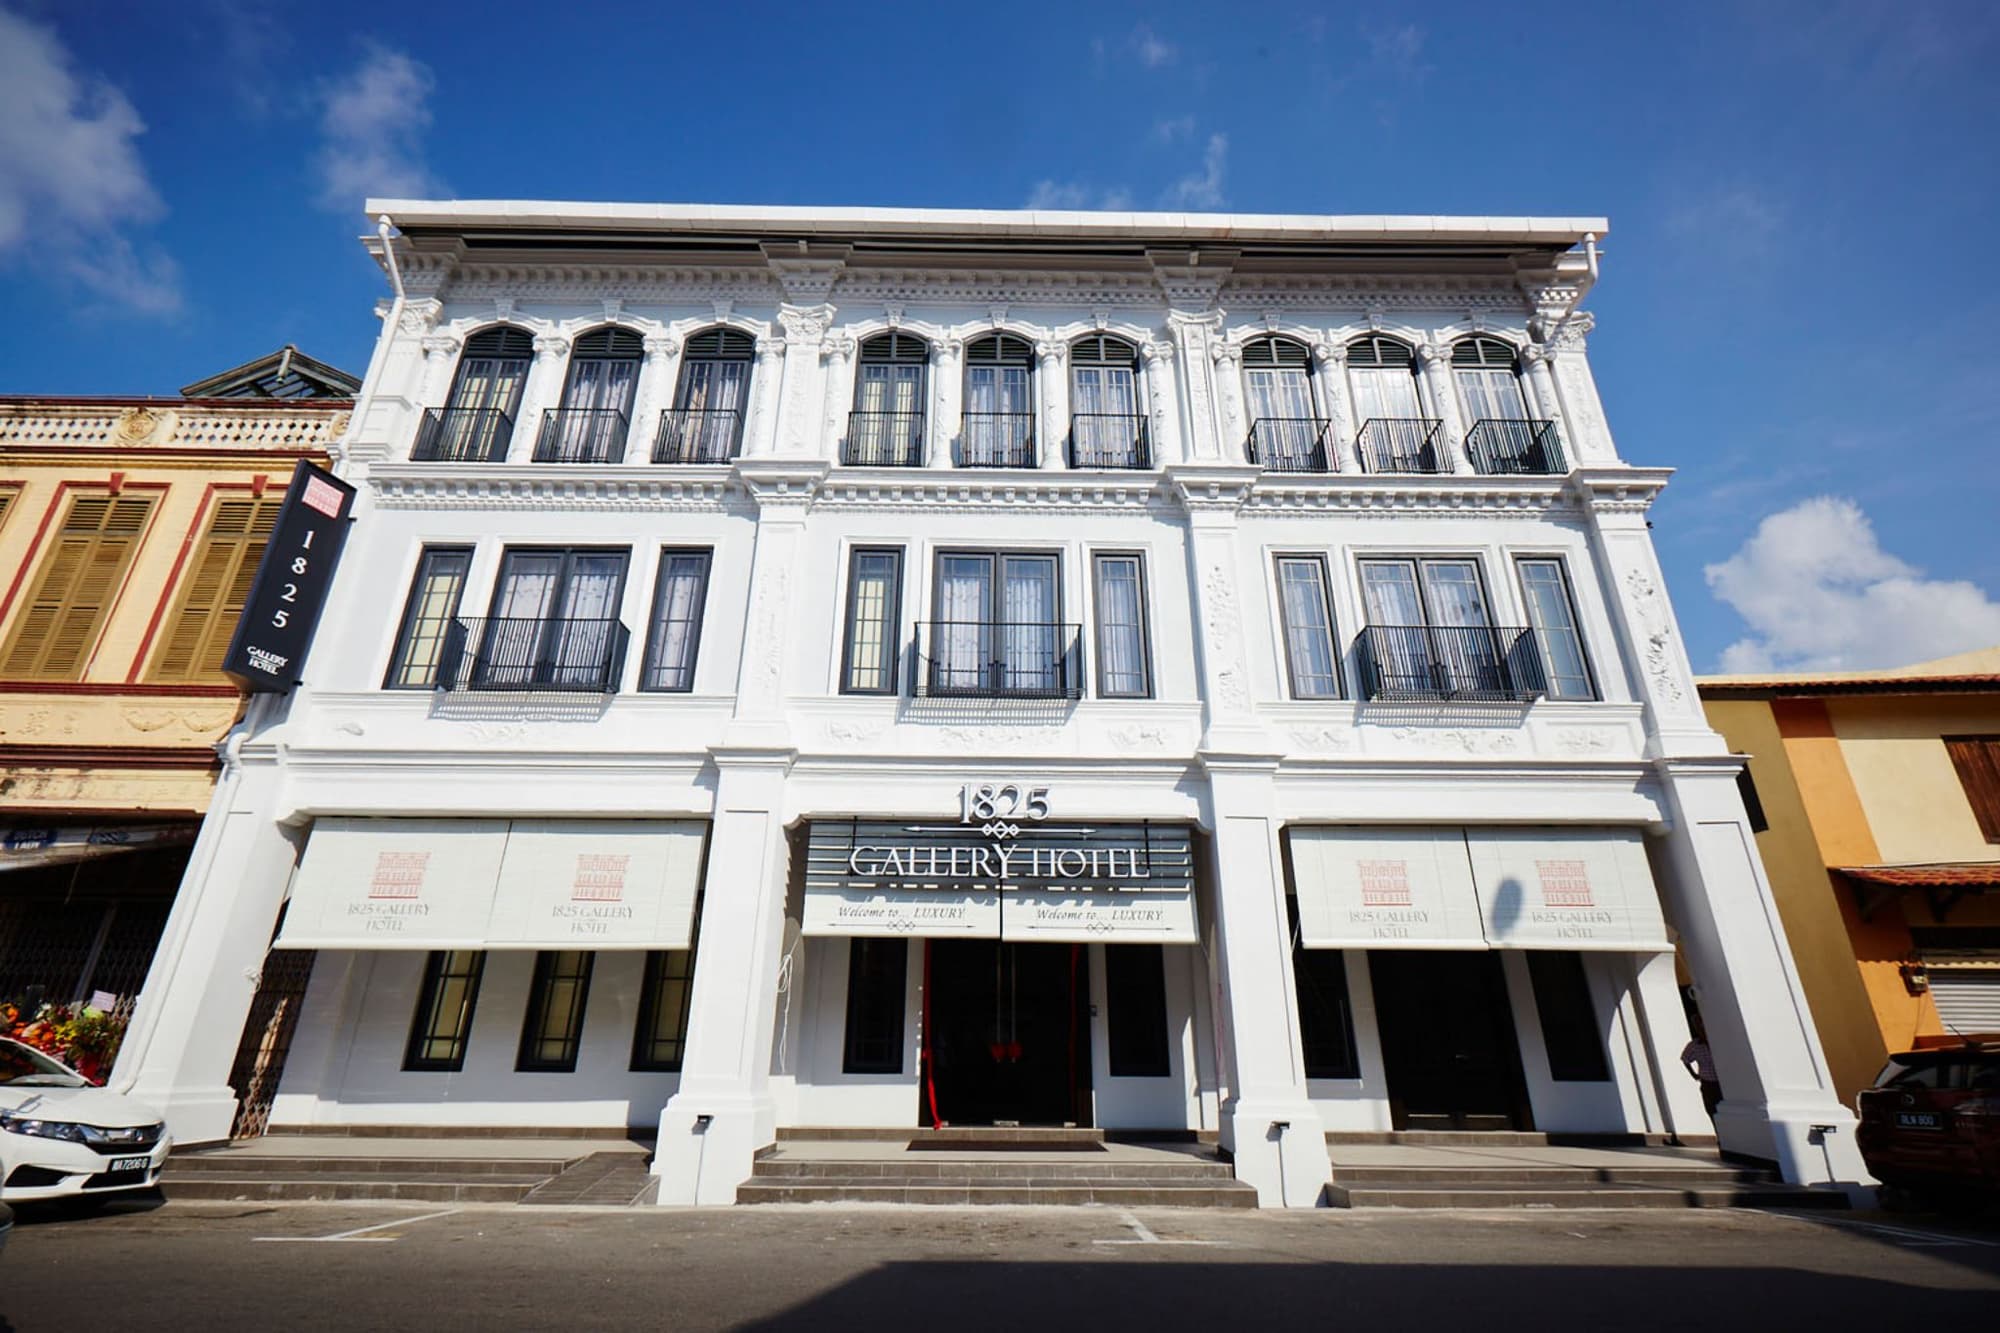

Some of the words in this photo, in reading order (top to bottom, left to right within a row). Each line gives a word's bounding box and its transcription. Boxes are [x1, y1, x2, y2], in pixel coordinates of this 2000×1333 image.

[271, 530, 315, 628] 1825
[246, 645, 289, 667] GALLERY
[248, 657, 279, 675] HOTEL
[957, 783, 1051, 824] 1825
[850, 843, 1017, 879] GALLERY
[1029, 847, 1150, 879] HOTEL
[347, 903, 375, 915] 1825
[376, 903, 430, 916] GALLERY
[552, 905, 578, 917] 1825
[579, 906, 633, 918] GALLERY
[838, 905, 885, 918] Welcome
[913, 907, 967, 918] LUXURY
[1037, 907, 1083, 920] Welcome
[1111, 909, 1164, 920] LUXURY
[1349, 911, 1374, 923] 1825
[1375, 911, 1430, 923] GALLERY
[1532, 911, 1558, 923] 1825
[1559, 912, 1612, 924] GALLERY
[366, 920, 404, 931] HOTEL
[571, 922, 608, 934] HOTEL
[1372, 927, 1409, 938] HOTEL
[1557, 927, 1595, 938] HOTEL
